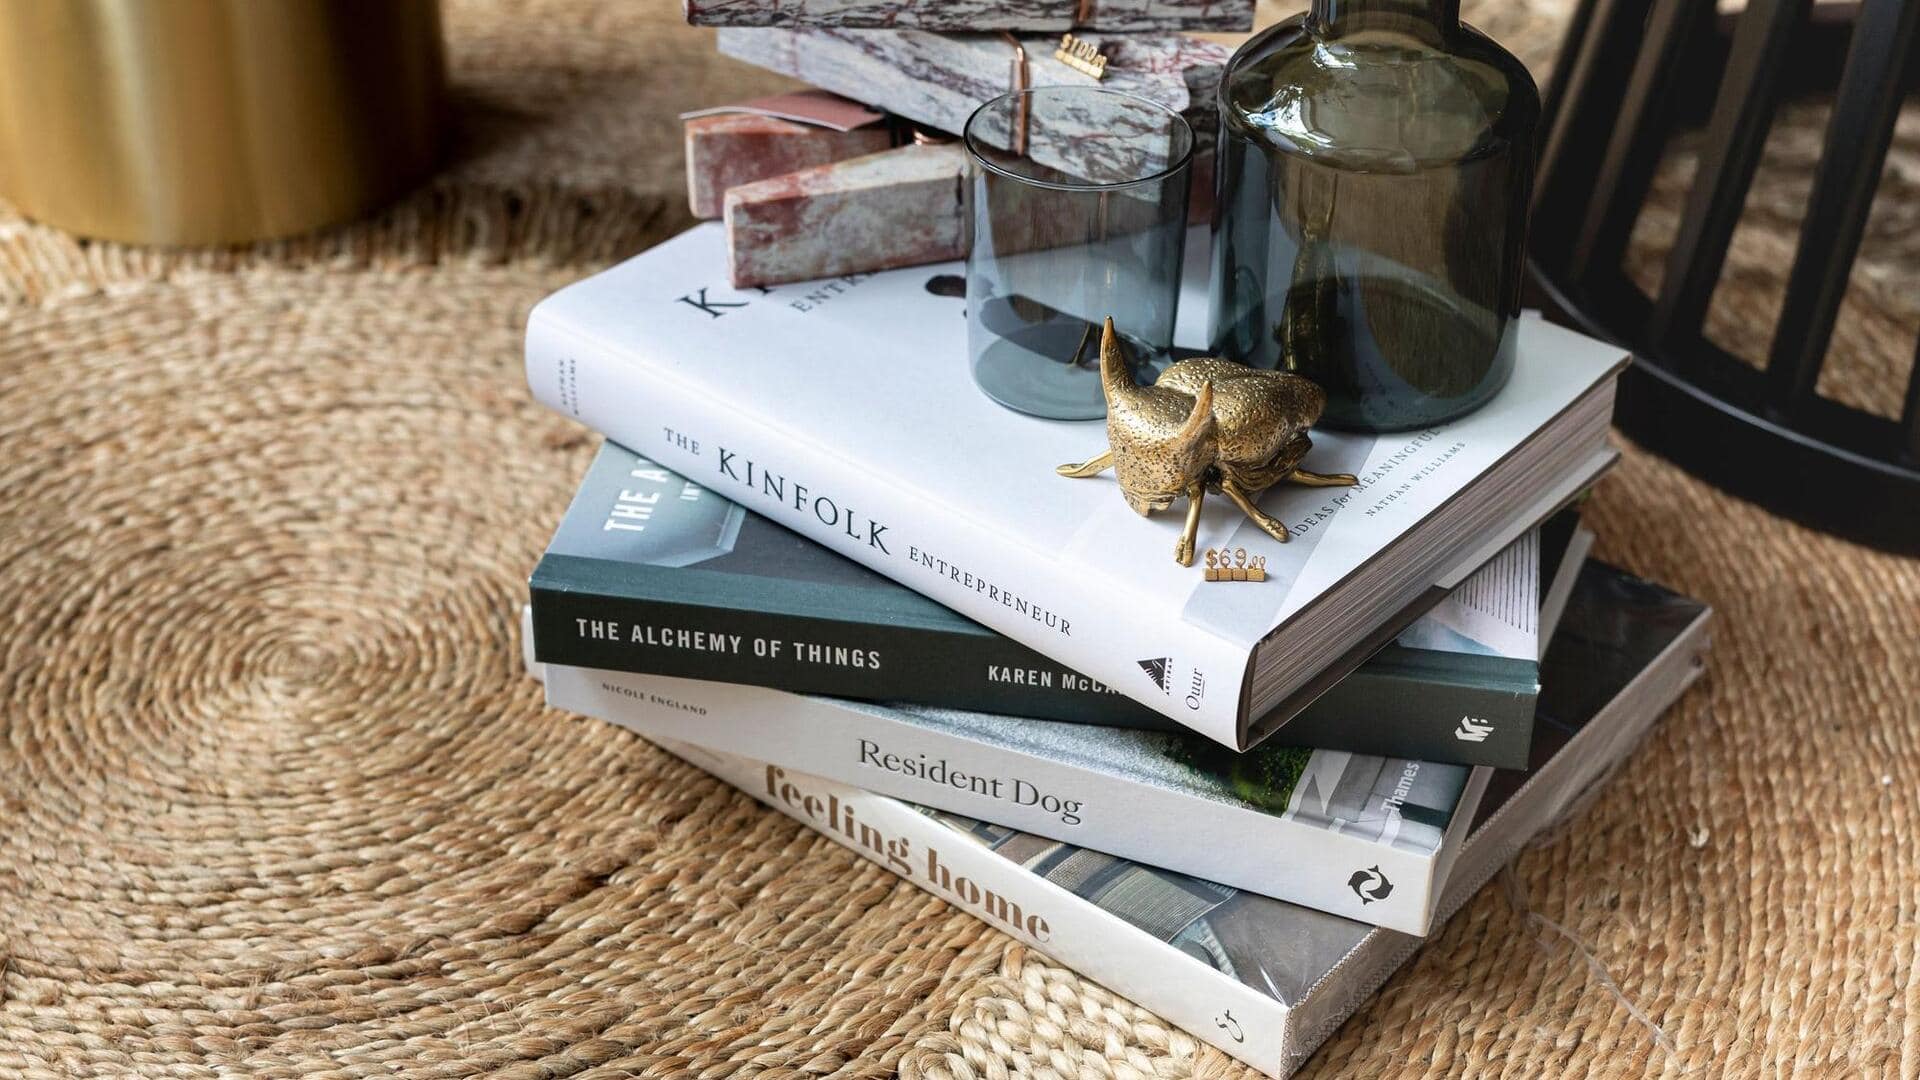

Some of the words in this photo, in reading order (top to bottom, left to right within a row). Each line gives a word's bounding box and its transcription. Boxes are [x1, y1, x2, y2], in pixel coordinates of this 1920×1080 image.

[630, 458, 672, 483] A
[1365, 482, 1411, 528] NATHAN
[1411, 442, 1466, 482] WILLIAMS
[603, 489, 661, 531] THE
[664, 427, 700, 456] THE
[718, 447, 891, 556] KINFOLK
[908, 545, 1072, 637] ENTREPRENEUR
[1290, 504, 1334, 537] IDEAS
[1332, 490, 1353, 509] for
[575, 618, 620, 642] THE
[630, 625, 742, 655] ALCHEMY
[753, 638, 782, 658] OF
[793, 642, 881, 670] THINGS
[988, 665, 1053, 688] KAREN
[602, 682, 646, 701] NICOLE
[650, 694, 708, 716] ENGLAND
[857, 738, 1004, 800] Resident
[1011, 778, 1084, 827] Dog
[1381, 761, 1421, 813] Thames
[764, 763, 914, 877] feeling
[927, 848, 1053, 945] home
